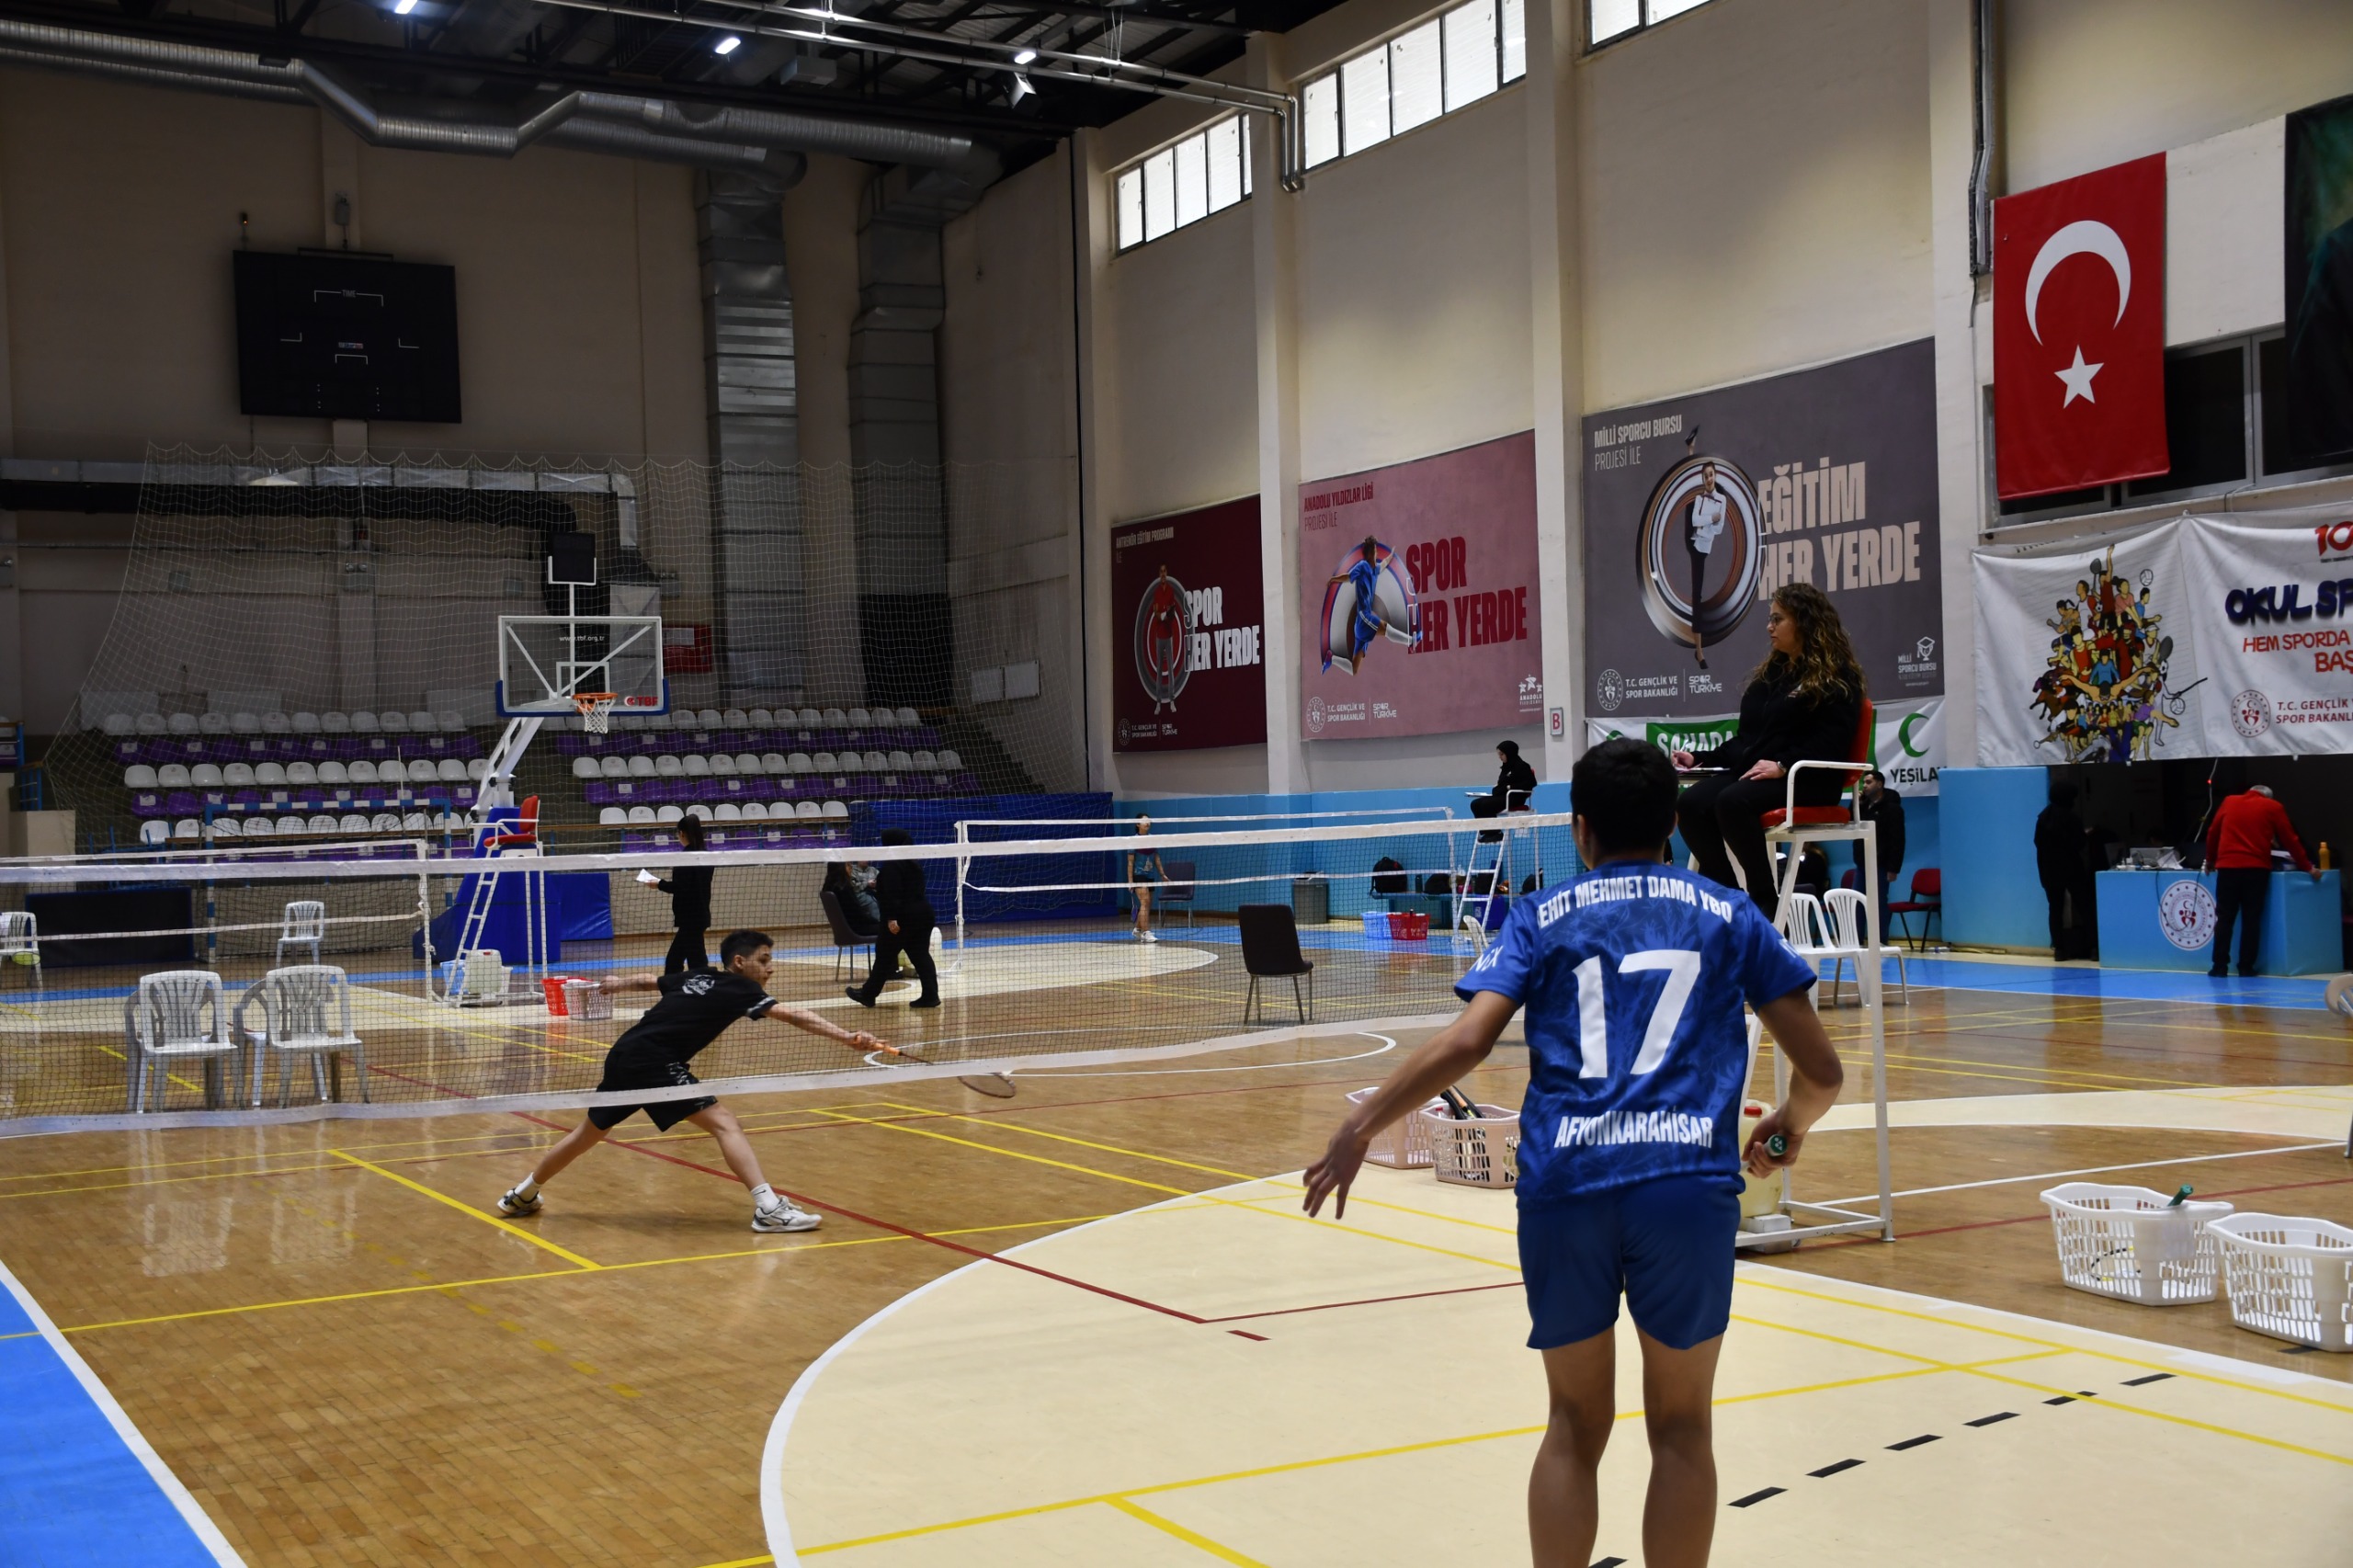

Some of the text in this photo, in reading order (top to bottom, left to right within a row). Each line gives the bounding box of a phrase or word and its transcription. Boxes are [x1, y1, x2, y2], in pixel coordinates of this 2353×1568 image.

[1595, 415, 1682, 448] MİLLİ SPORCU BURSU
[1595, 445, 1641, 471] PROJESİ İLE
[1304, 482, 1374, 512] ANADOLU YILDIZLAR LİGİ
[1757, 456, 1866, 536] EĞİTİM
[1406, 536, 1467, 596] SPOR
[1821, 521, 1920, 592] YERDE
[1184, 586, 1223, 629] SPOR
[1407, 586, 1528, 654] HER YERDE
[2224, 585, 2313, 626] OKUL
[1184, 625, 1260, 672] HER YERDE
[2243, 630, 2350, 653] HEM SPORDA
[1625, 676, 1677, 687] T.C. GENÇLİK VE
[1625, 686, 1678, 699] SPOR BAKANLIĞI
[637, 697, 658, 706] TBF
[2278, 697, 2348, 711] T.C. GENÇLİK
[1327, 714, 1339, 722] SPOR
[1552, 713, 1561, 730] B
[2276, 714, 2305, 724] SPOR
[1891, 767, 1947, 786] YEŞİLA
[1537, 875, 1732, 930] EHİT MEHMET DAMA YBO
[1572, 949, 1700, 1079] 17
[1553, 1106, 1712, 1149] AFYONKARAHİSAR
